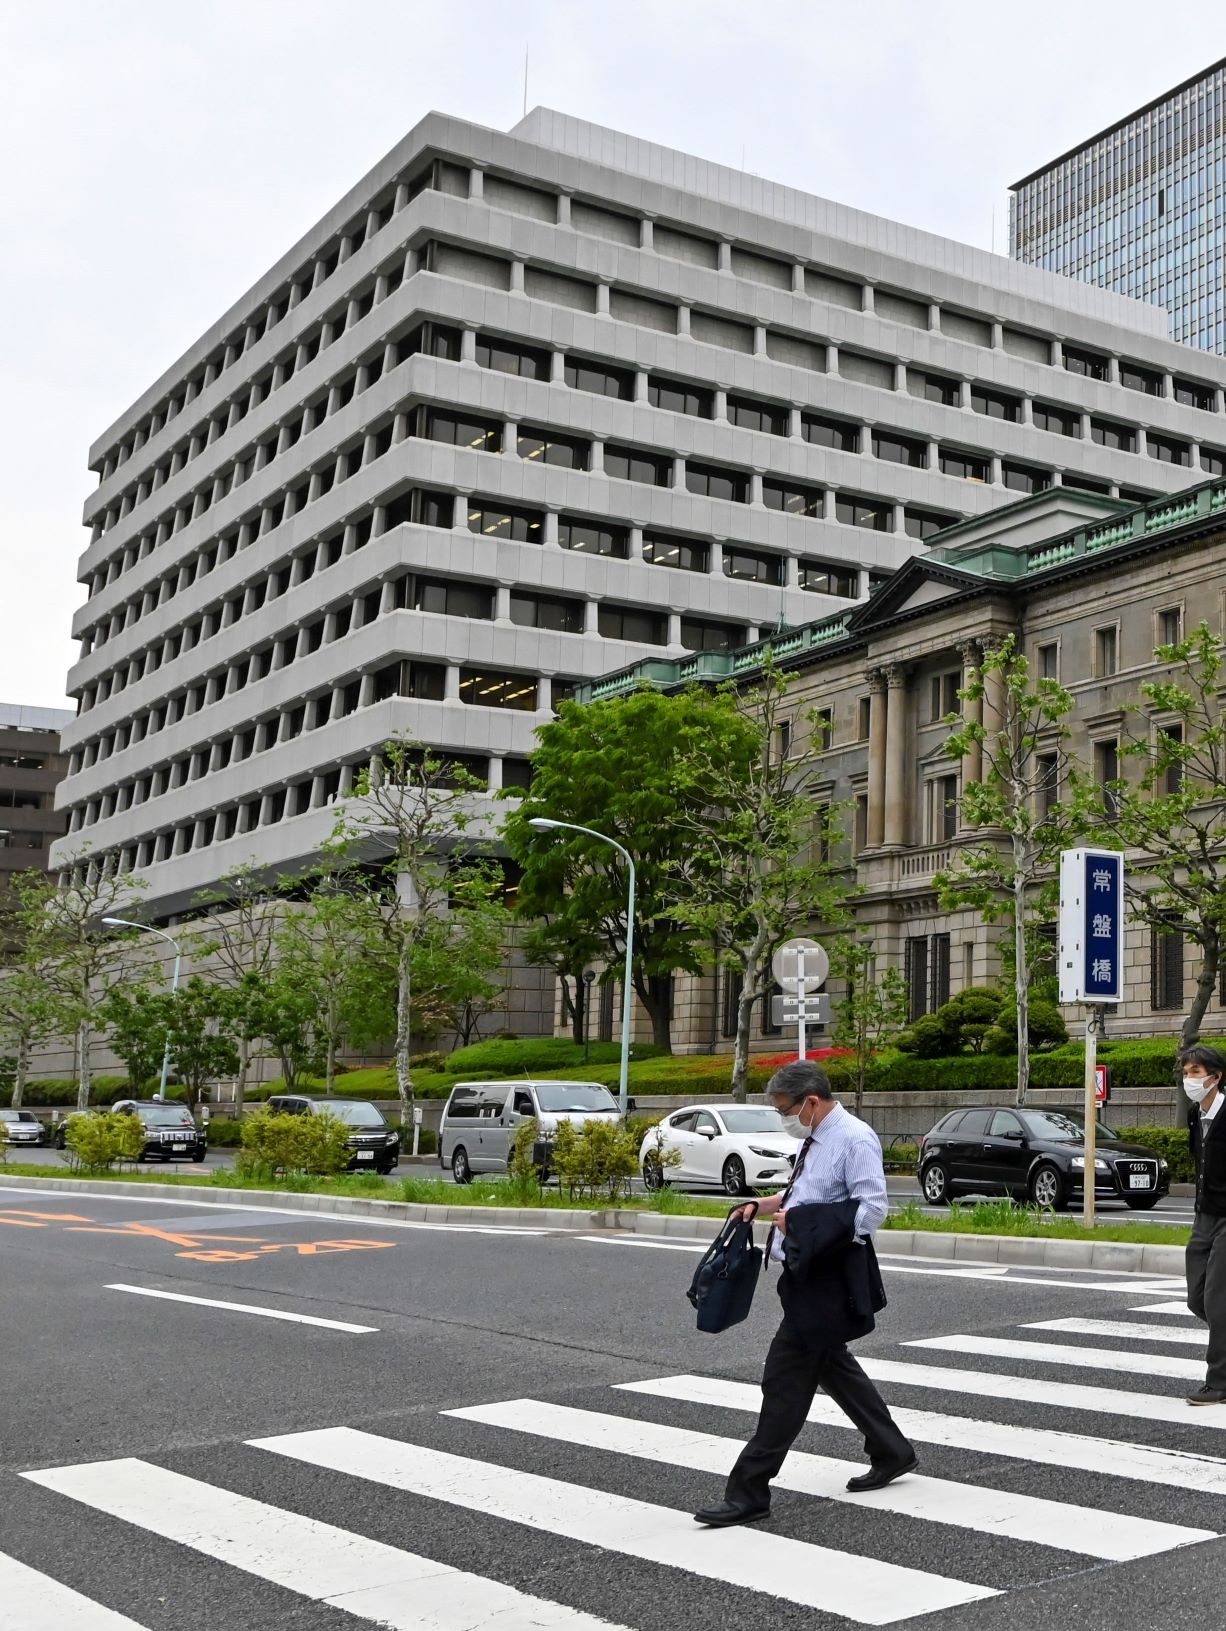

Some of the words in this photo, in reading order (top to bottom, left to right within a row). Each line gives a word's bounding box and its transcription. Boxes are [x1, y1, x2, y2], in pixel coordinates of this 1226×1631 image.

[1091, 869, 1112, 983] 常盤橋
[174, 1239, 399, 1262] 8-20
